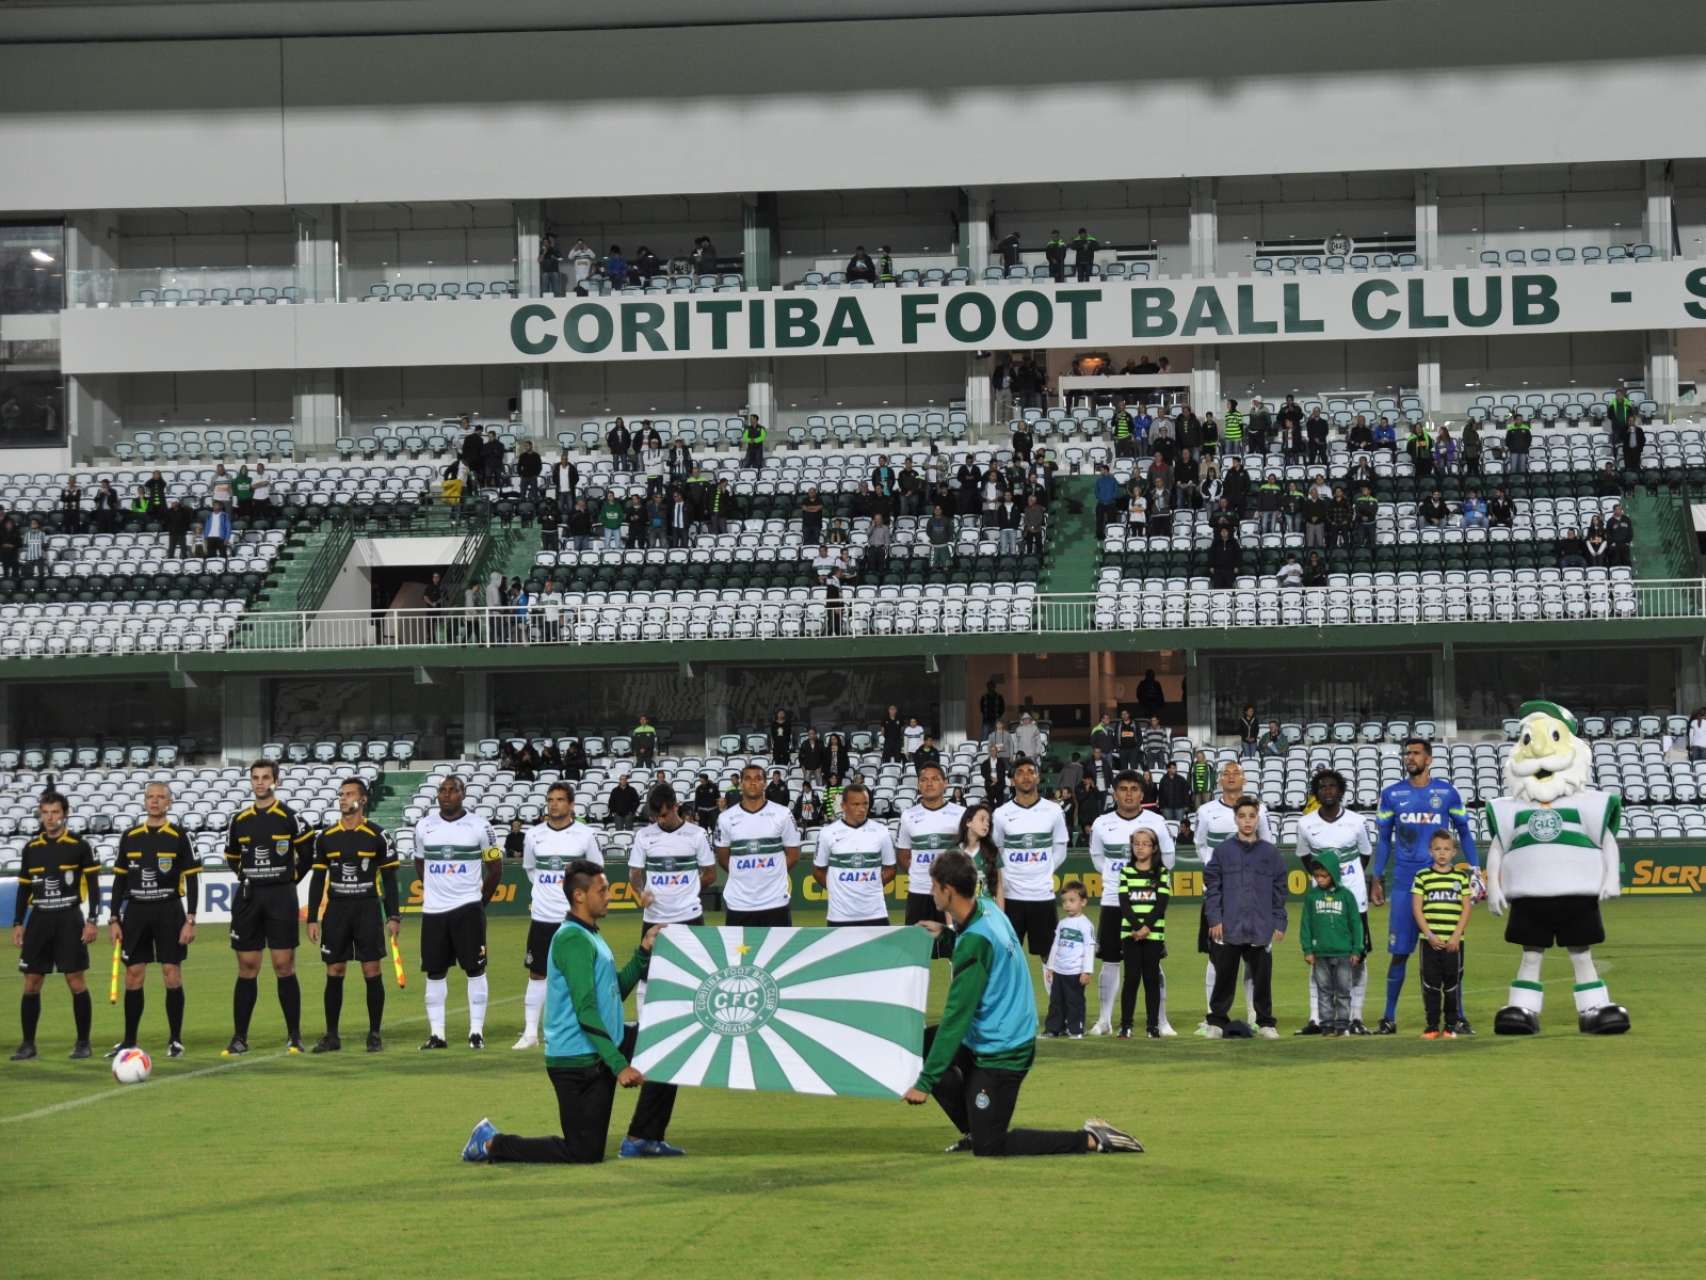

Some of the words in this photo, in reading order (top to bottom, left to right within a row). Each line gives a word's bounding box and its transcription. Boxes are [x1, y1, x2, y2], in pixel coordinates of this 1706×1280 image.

[510, 296, 874, 354] CORITIBA
[902, 289, 1103, 343] FOOT
[1131, 283, 1324, 338] BALL
[1352, 274, 1560, 331] CLUB
[1400, 812, 1442, 824] CAIXA
[736, 857, 776, 870] CAIXA
[1009, 851, 1048, 864] CAIXA
[429, 863, 467, 876] CAIXA
[651, 874, 690, 888] CAIXA
[838, 871, 877, 883] CAIXA
[1129, 890, 1157, 901] AIXA
[1428, 891, 1457, 901] CAIXA
[714, 992, 759, 1008] CFC
